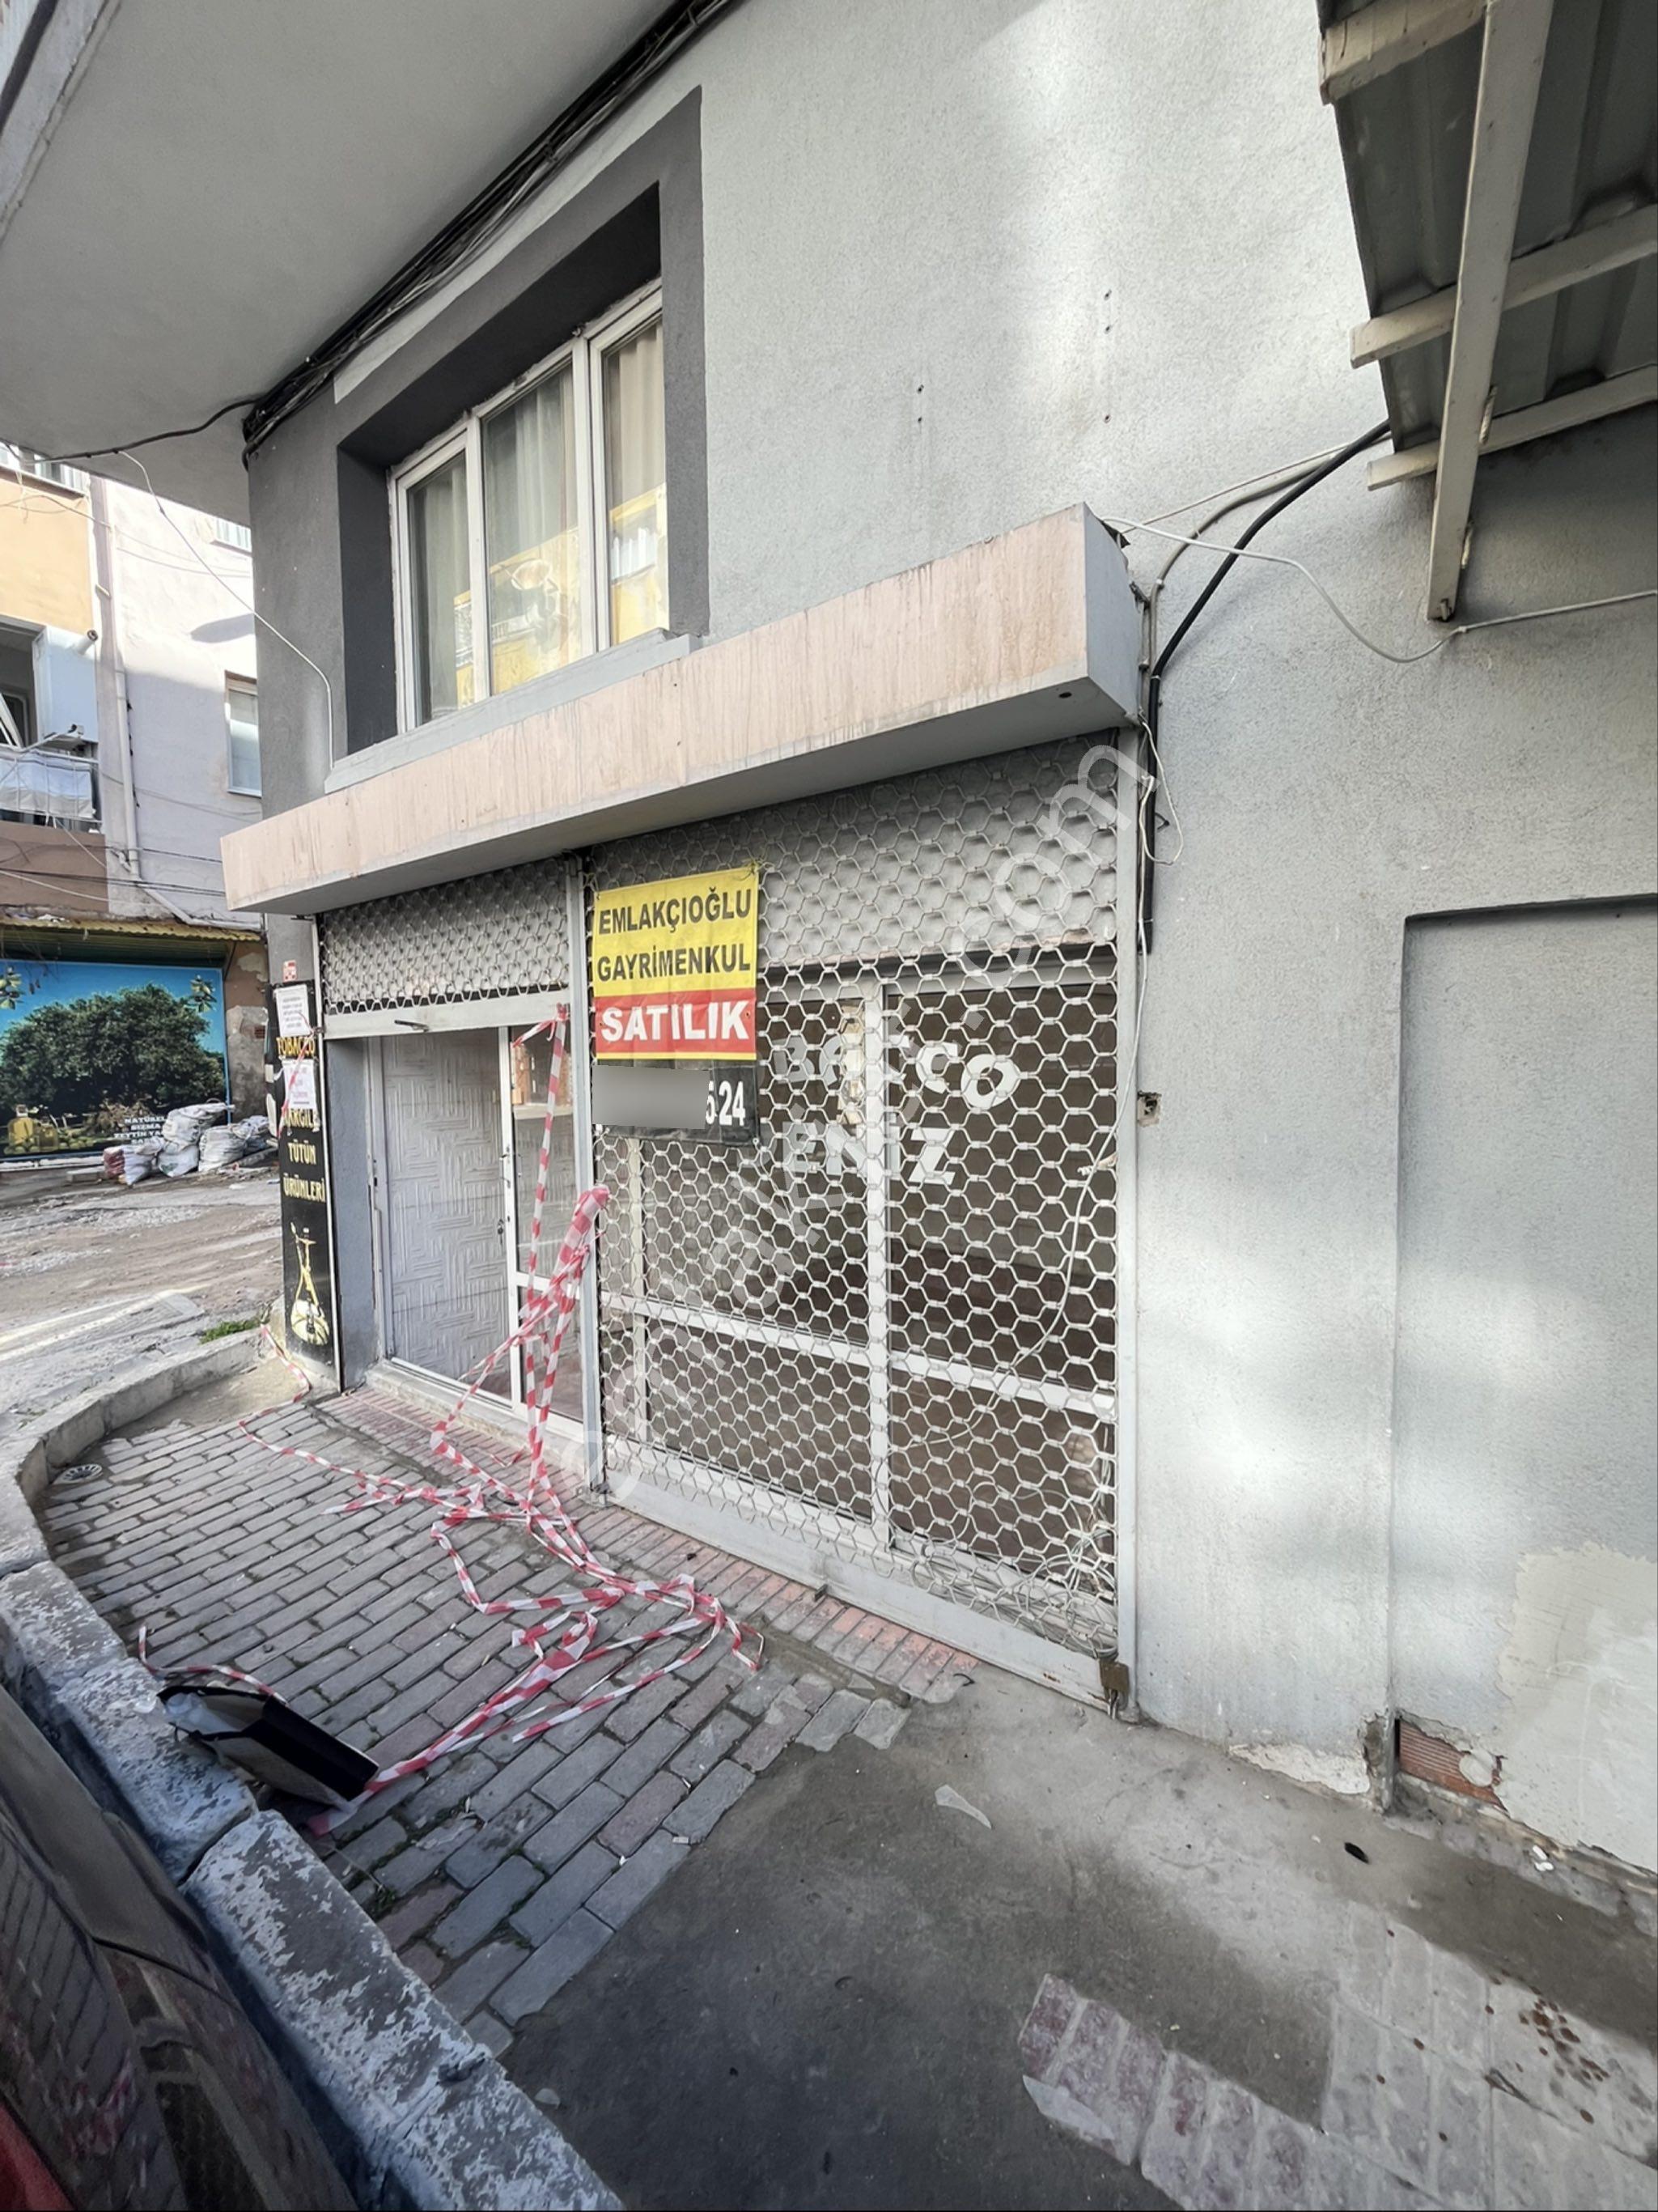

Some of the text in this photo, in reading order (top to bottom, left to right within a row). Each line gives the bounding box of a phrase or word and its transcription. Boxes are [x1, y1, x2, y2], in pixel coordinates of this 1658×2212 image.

[599, 886, 751, 934] EMLAKÇIOĞLU
[597, 943, 751, 981] GAYRİMENKUL
[601, 1000, 748, 1042] SATILIK
[287, 1139, 316, 1165] TÜTÜN
[283, 1172, 325, 1203] ÜRÜNLERİ
